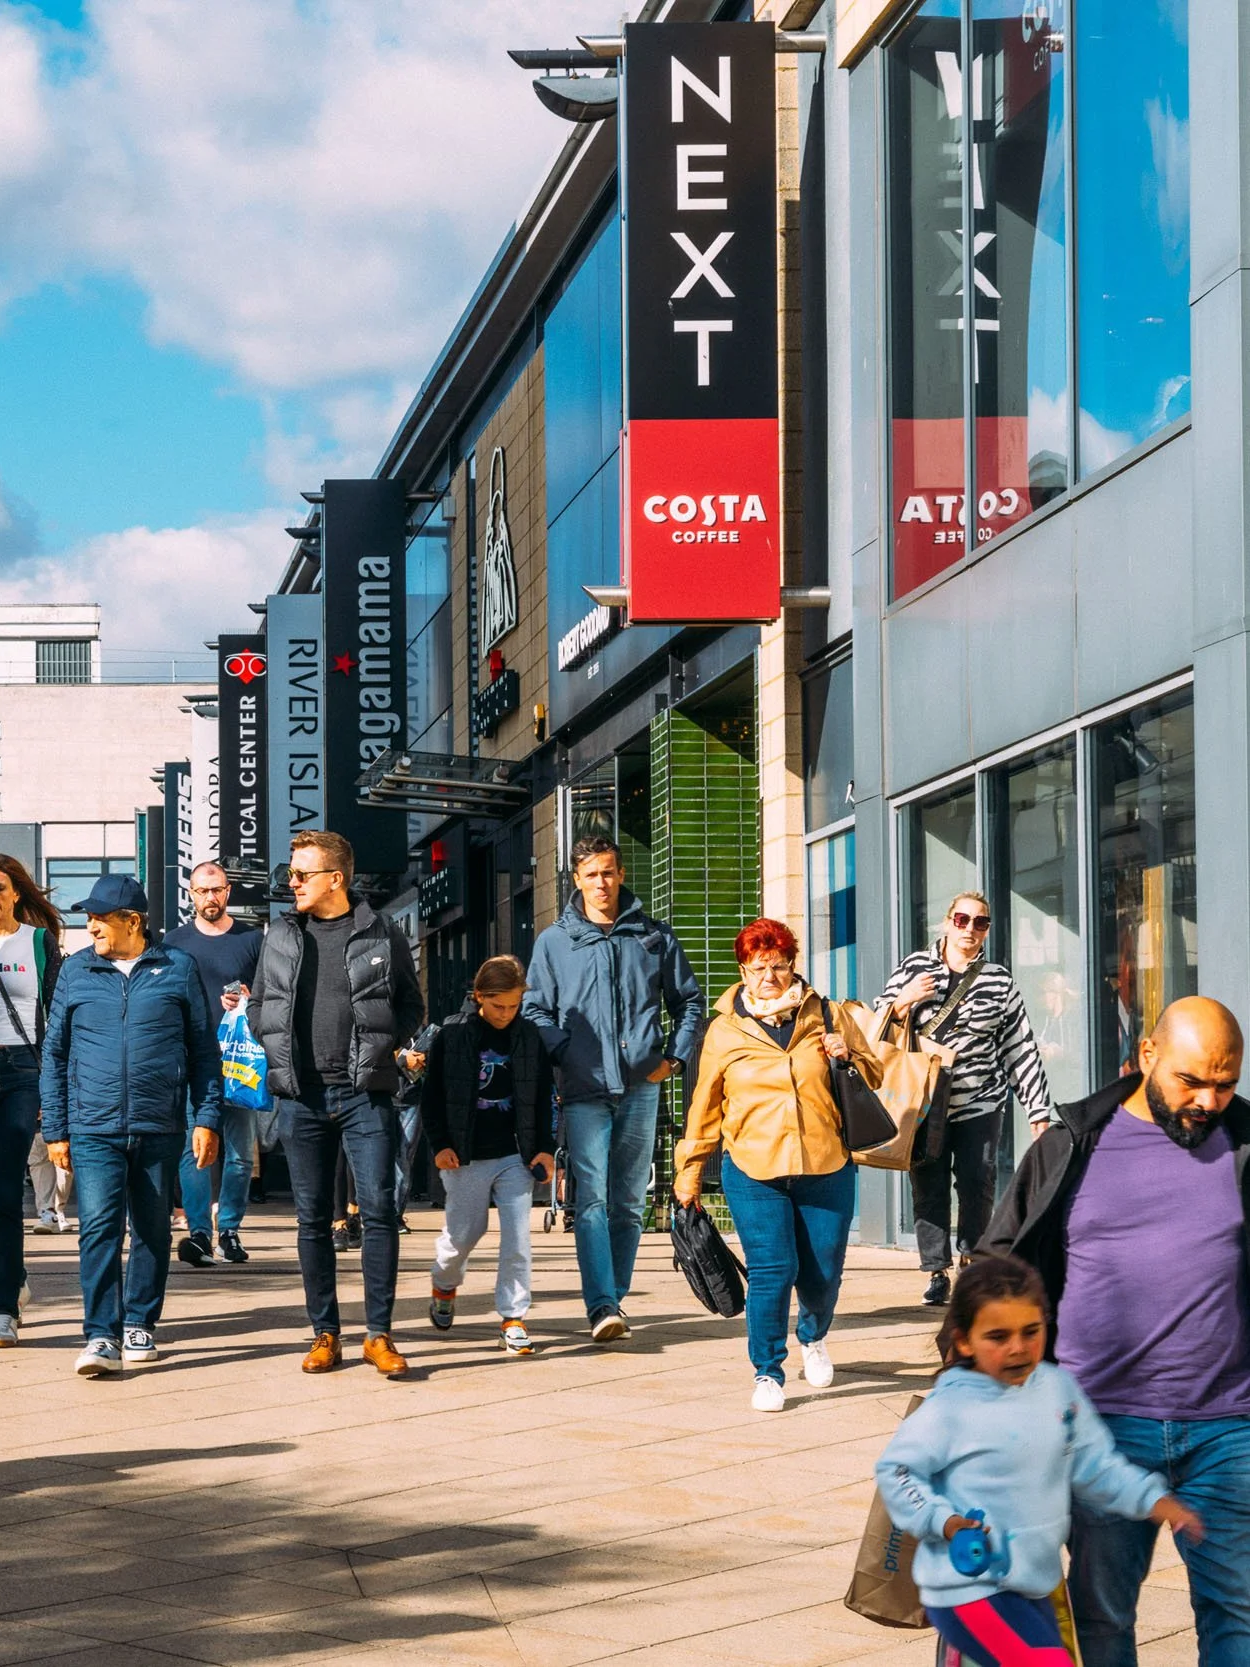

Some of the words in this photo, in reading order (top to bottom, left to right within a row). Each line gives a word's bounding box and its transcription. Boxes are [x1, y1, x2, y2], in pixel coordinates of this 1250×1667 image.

[670, 55, 735, 386] NEXT
[643, 494, 767, 527] COSTA
[672, 531, 740, 544] COFFEE
[288, 638, 319, 737] RIVER
[240, 695, 257, 787] CENTER
